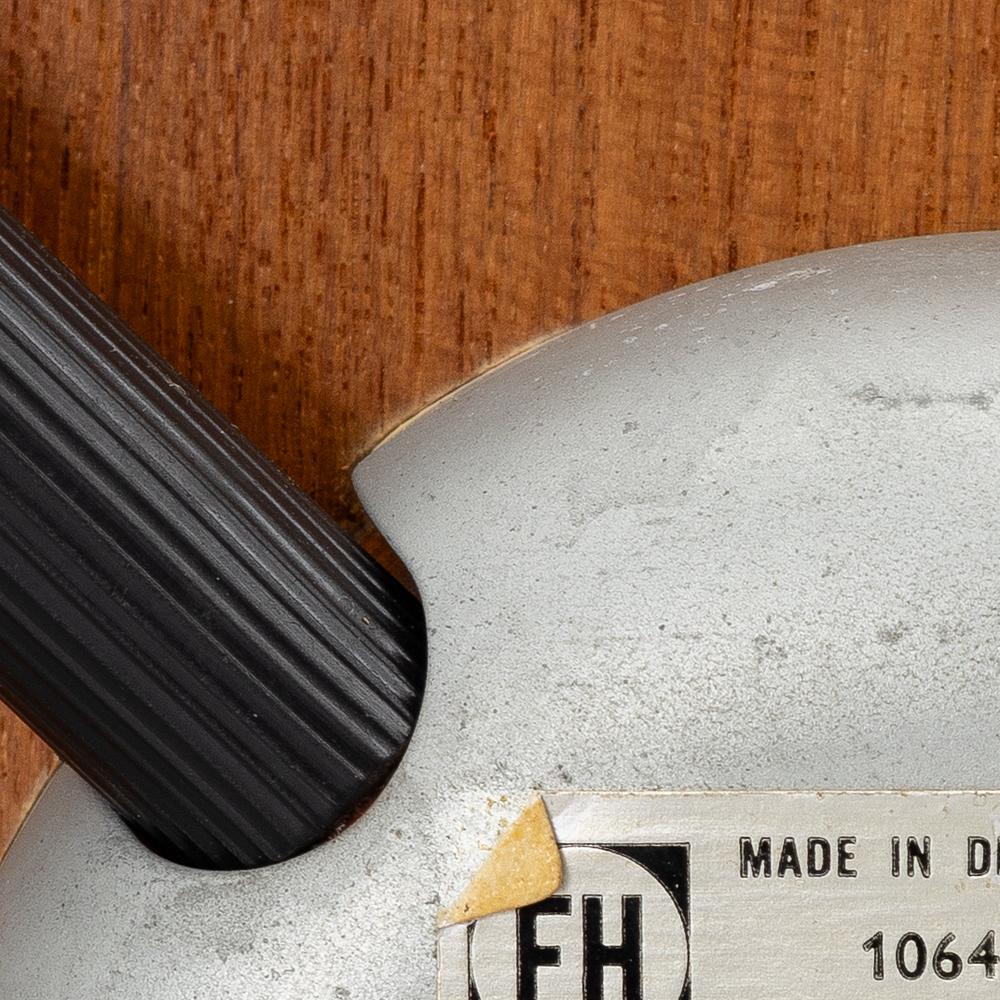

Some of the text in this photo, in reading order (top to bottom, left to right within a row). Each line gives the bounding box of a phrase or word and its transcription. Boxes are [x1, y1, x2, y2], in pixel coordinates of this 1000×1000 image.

[738, 835, 858, 879] MADE
[891, 835, 932, 879] IN
[861, 928, 1000, 981] 1064
